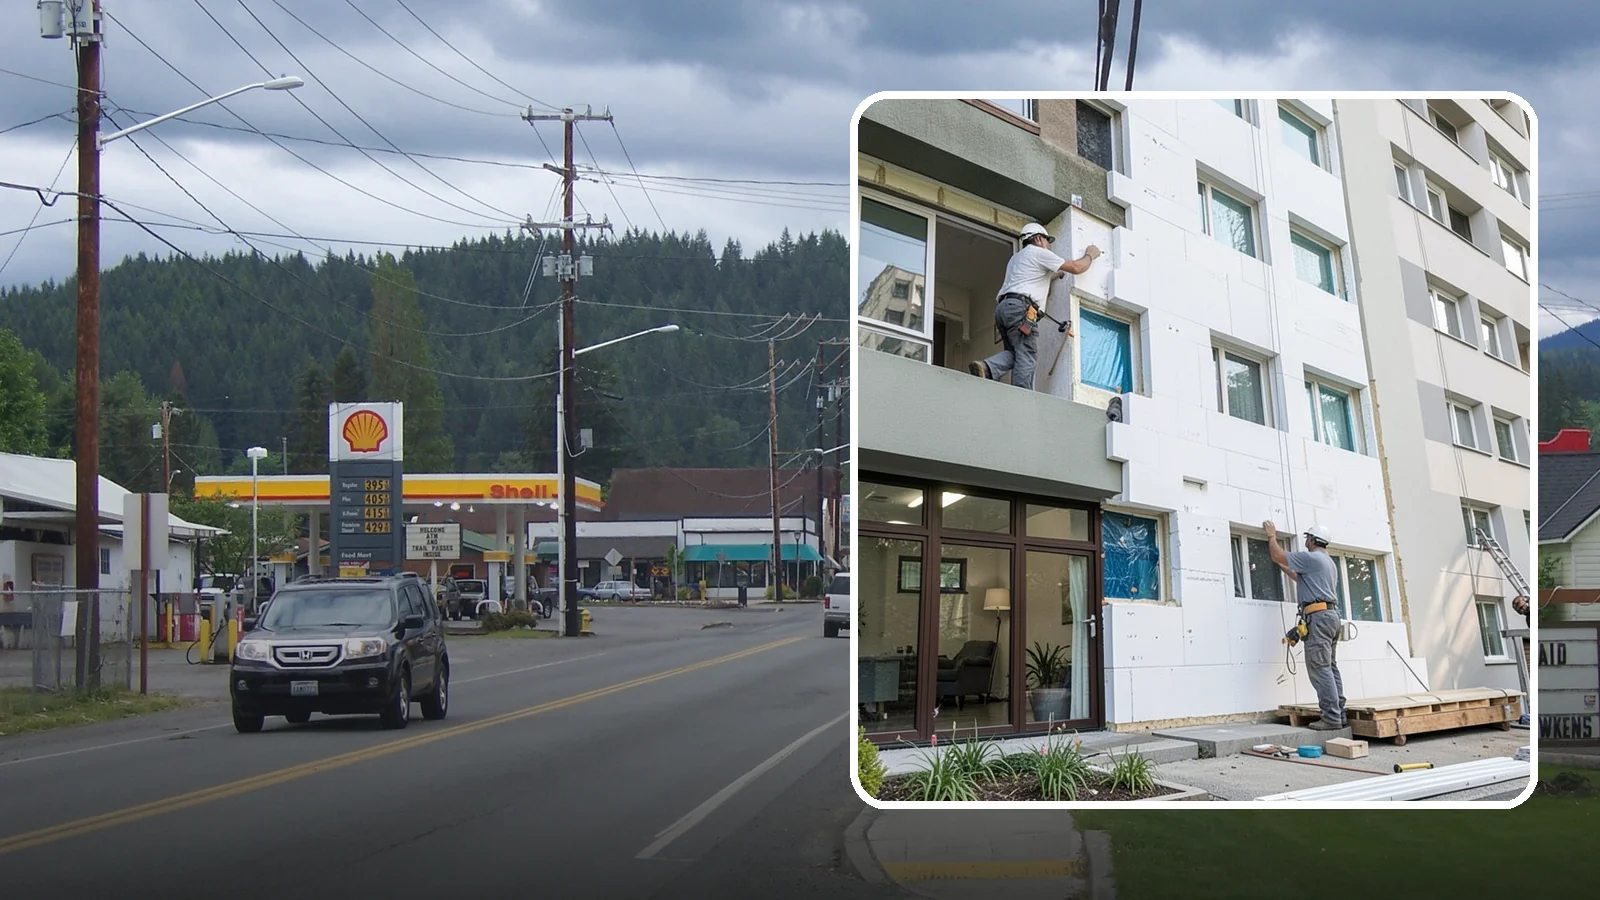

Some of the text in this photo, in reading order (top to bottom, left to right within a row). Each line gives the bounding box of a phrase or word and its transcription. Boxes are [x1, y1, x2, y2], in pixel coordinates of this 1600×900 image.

[365, 480, 384, 490] 395
[490, 484, 547, 499] Shell
[365, 494, 384, 504] 405
[365, 508, 384, 518] 415
[365, 522, 384, 533] 429
[1538, 642, 1567, 666] AID
